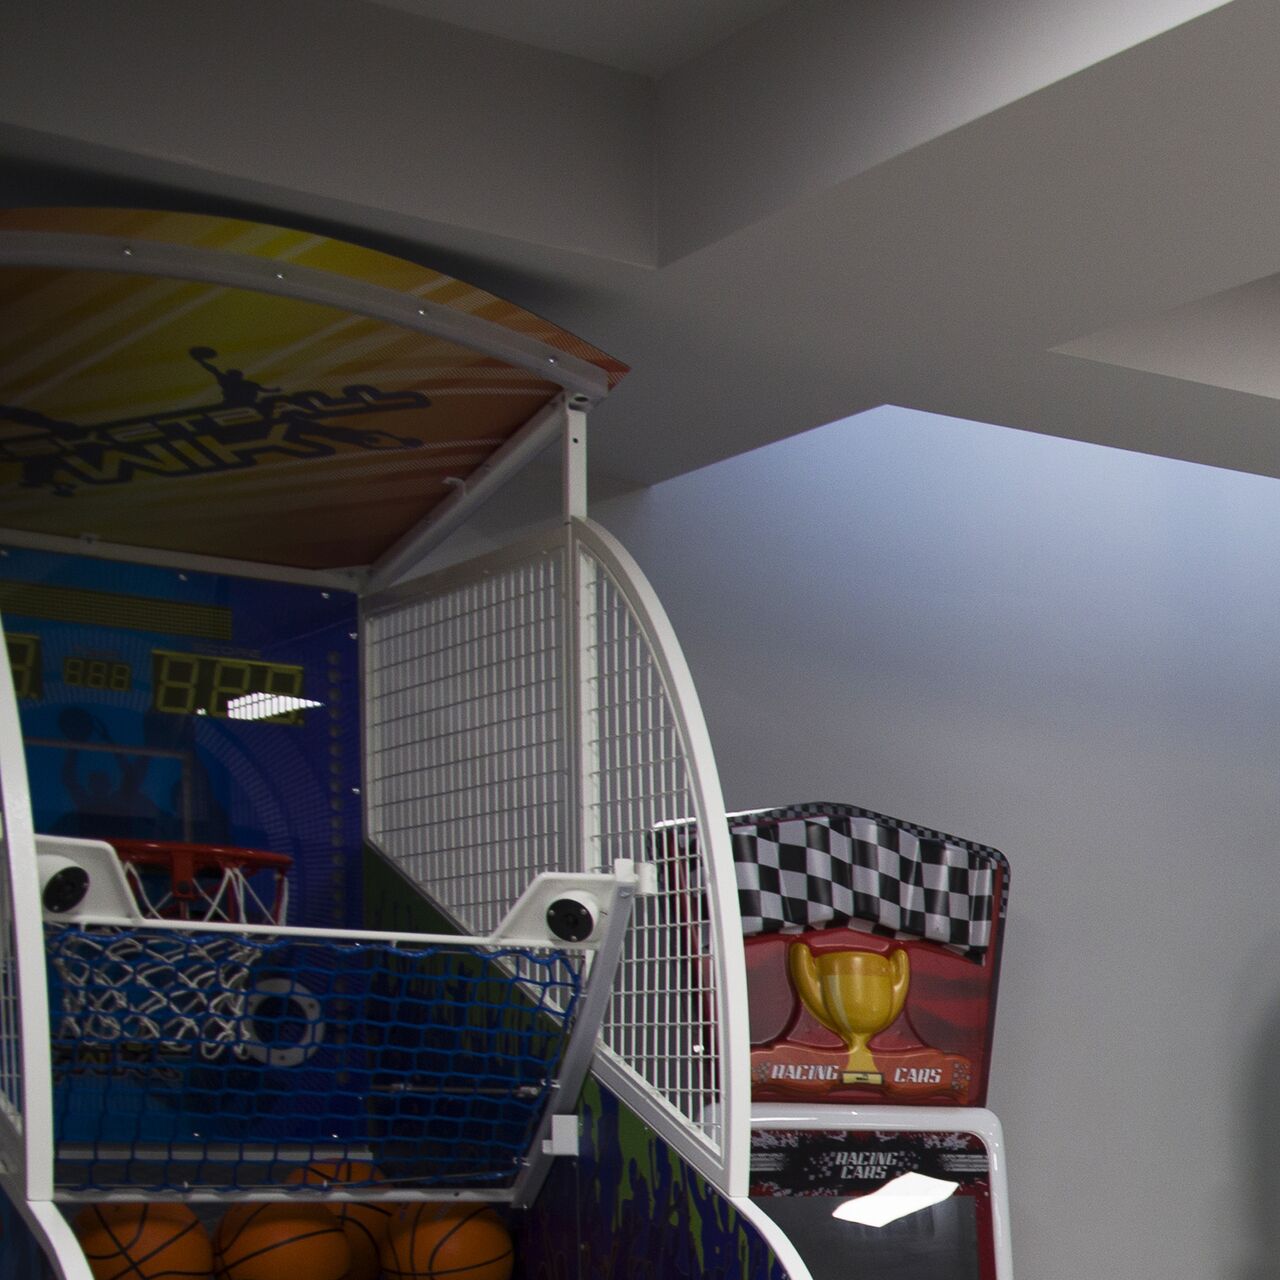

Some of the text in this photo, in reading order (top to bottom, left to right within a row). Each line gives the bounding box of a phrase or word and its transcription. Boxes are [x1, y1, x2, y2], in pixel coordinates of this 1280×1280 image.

[771, 1064, 943, 1084] RACING CARS
[835, 1152, 899, 1166] RACING
[841, 1165, 889, 1180] CARS
